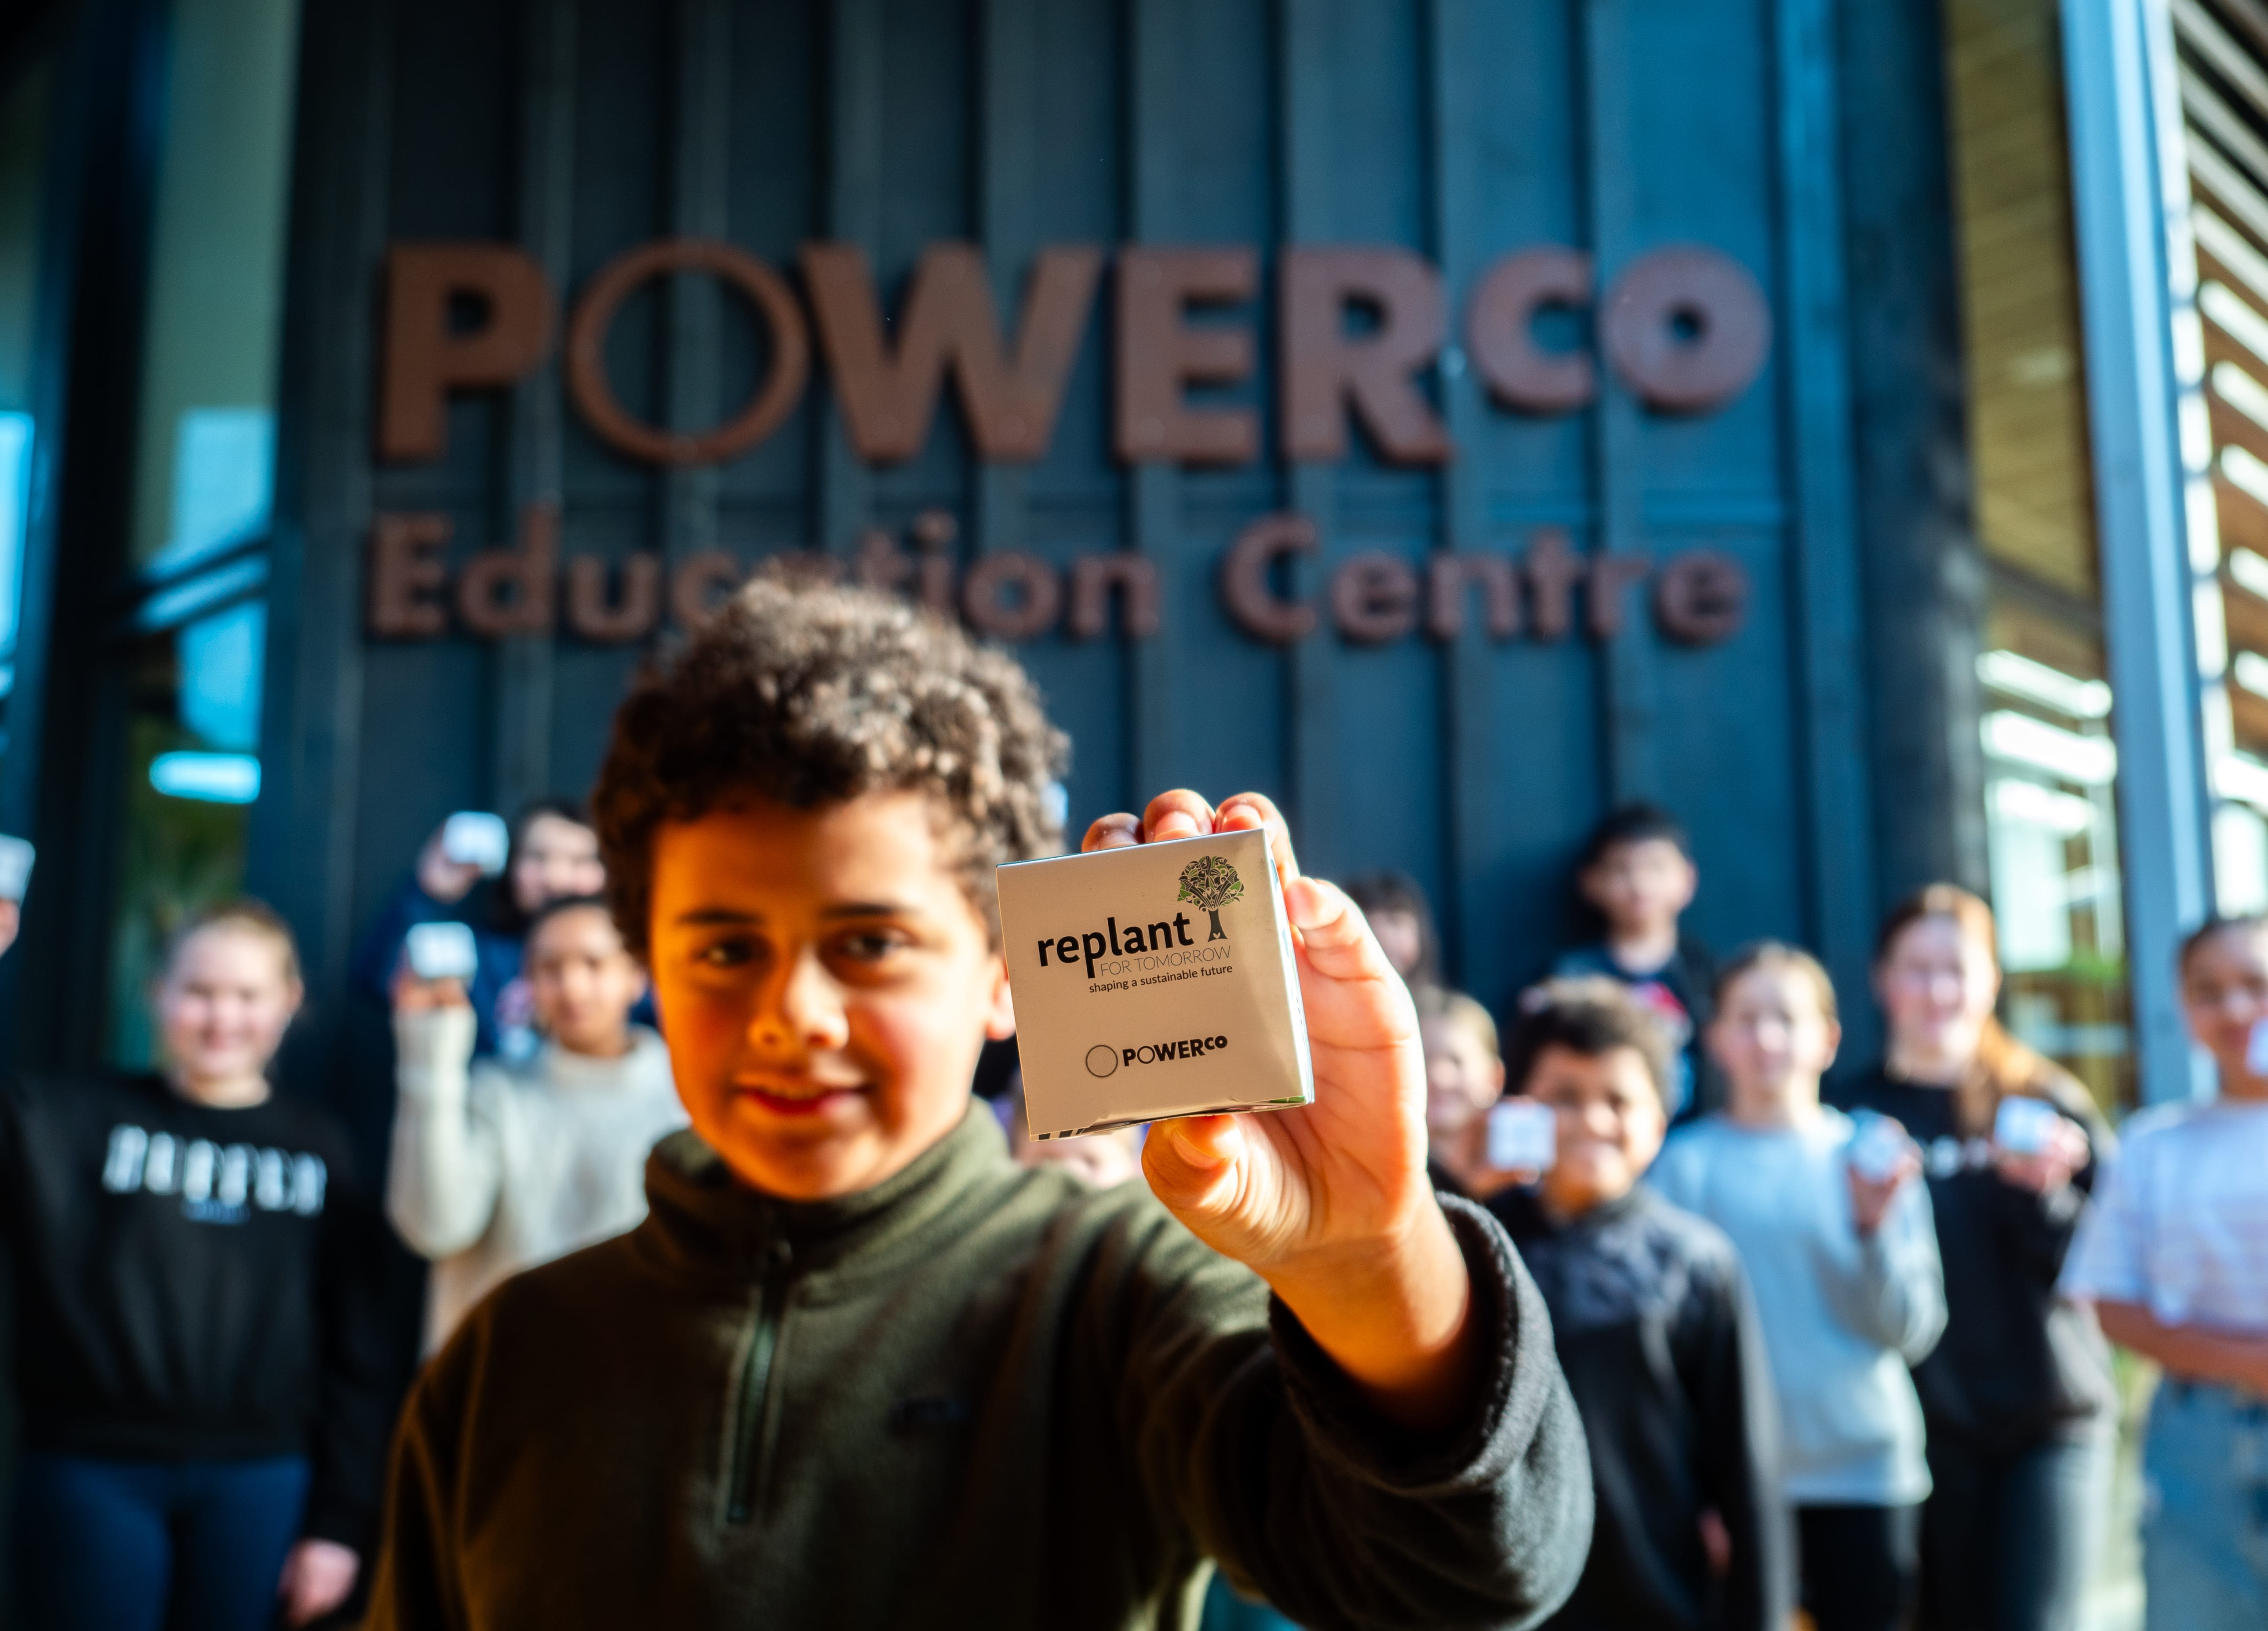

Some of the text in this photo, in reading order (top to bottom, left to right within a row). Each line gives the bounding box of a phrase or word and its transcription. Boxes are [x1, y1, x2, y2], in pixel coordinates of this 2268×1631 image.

[1220, 513, 1748, 644] Centre
[1038, 912, 1194, 979] replant
[1101, 945, 1231, 976] FOR TOMORROW
[1089, 980, 1129, 993] shaping
[1140, 969, 1198, 986] sustainable
[1201, 965, 1233, 977] future
